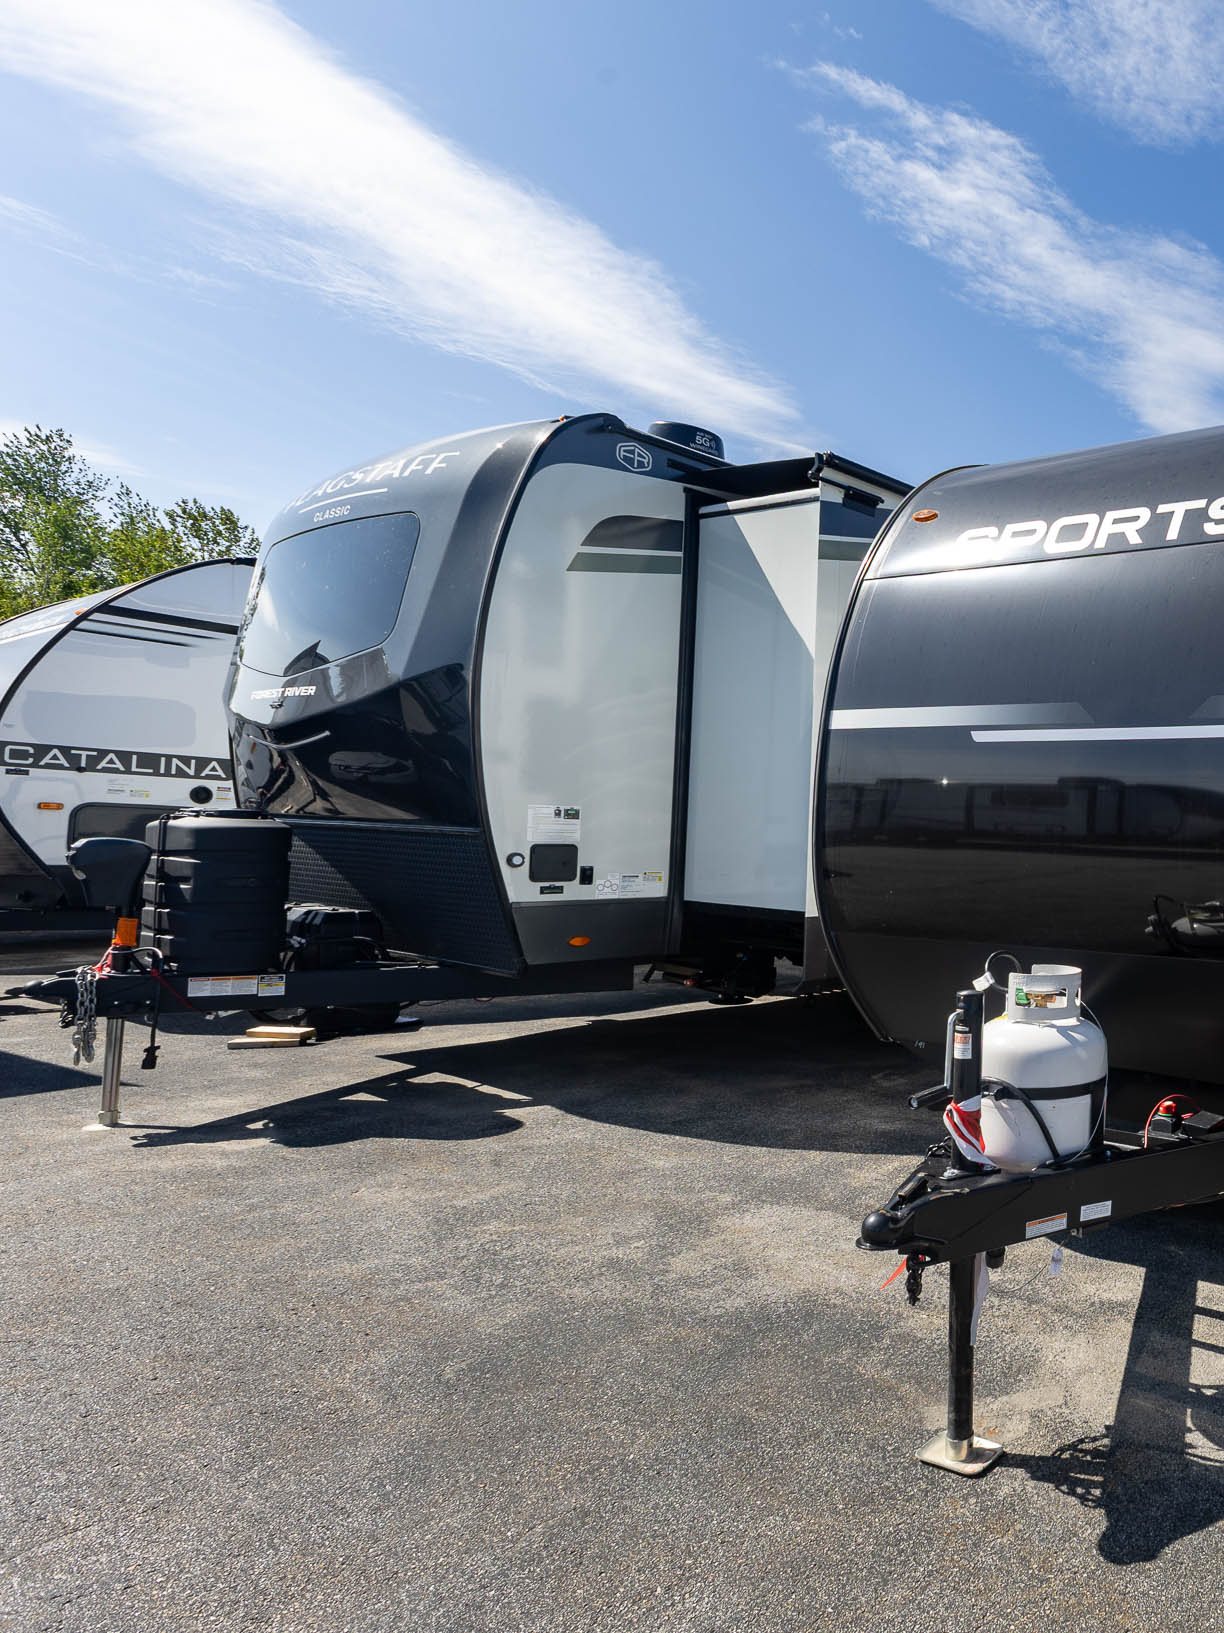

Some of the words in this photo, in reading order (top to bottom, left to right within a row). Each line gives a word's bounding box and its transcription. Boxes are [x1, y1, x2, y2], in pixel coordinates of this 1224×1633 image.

[695, 435, 711, 448] 5G
[313, 504, 351, 522] CLASSIC
[284, 685, 317, 697] RIVER
[3, 744, 227, 778] CATALINA
